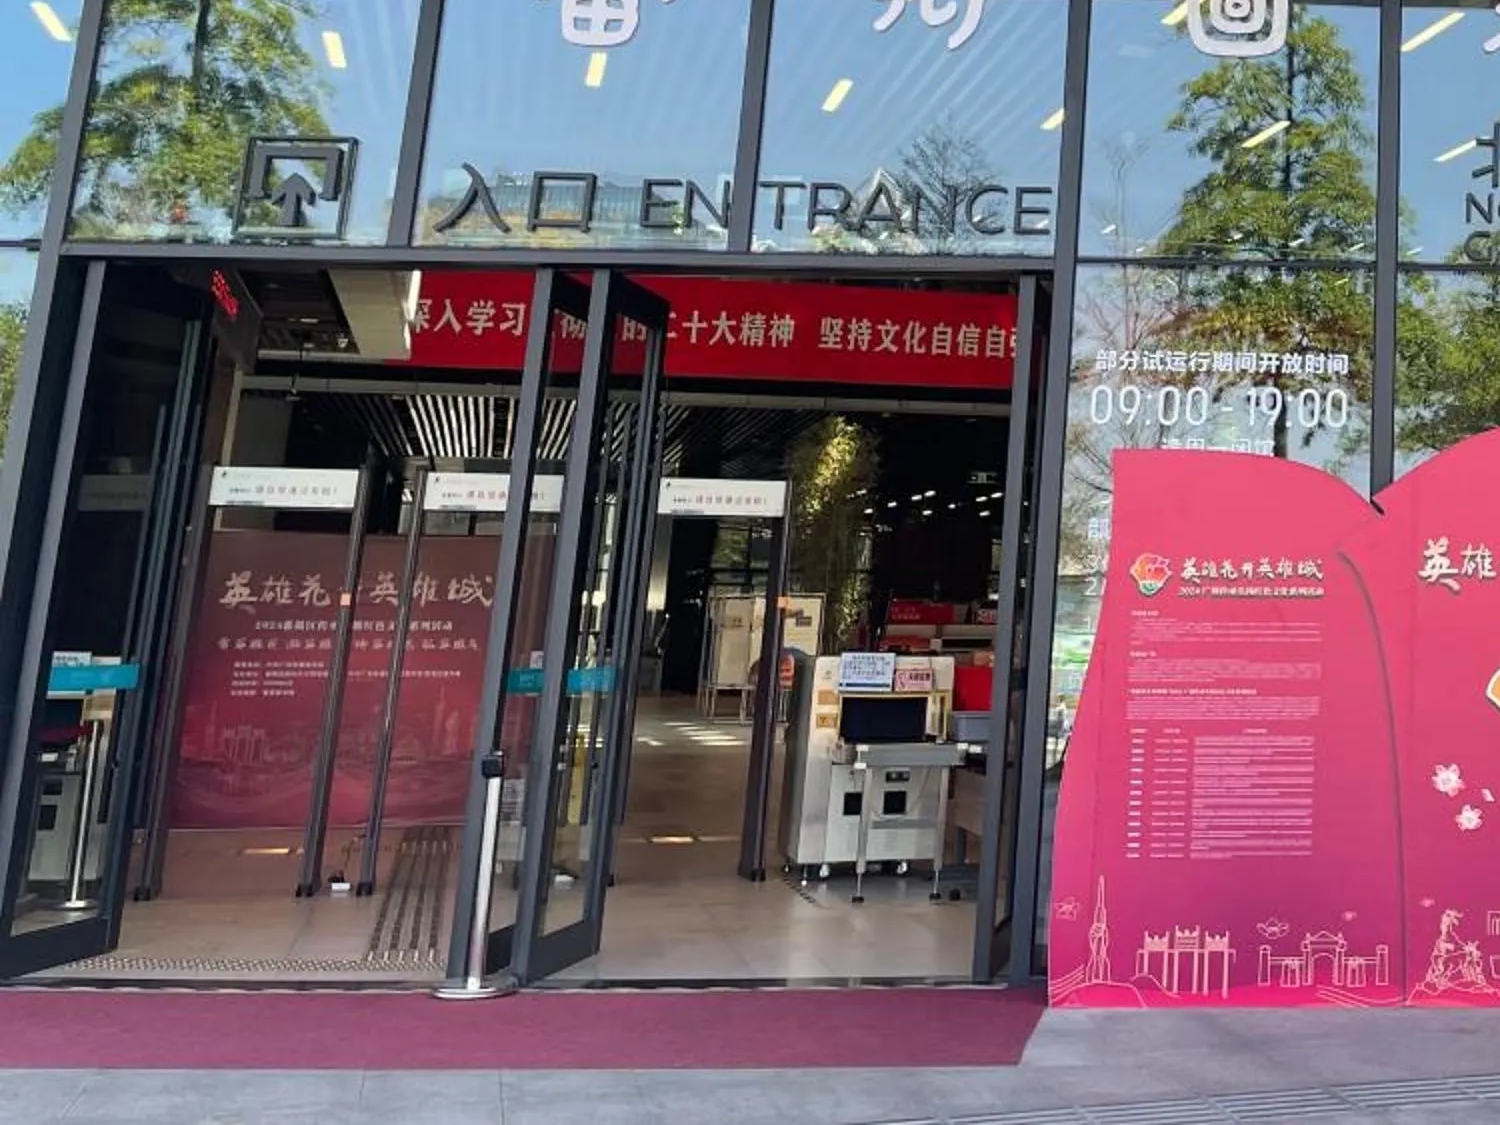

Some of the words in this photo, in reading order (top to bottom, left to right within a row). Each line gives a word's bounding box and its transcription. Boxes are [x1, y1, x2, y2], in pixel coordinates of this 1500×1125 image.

[432, 162, 600, 235] 入口
[1095, 349, 1349, 375] 部分试运行期间开放时间
[1180, 556, 1324, 583] 英雄花开英雄城
[219, 570, 494, 614] 英雄花英雄城
